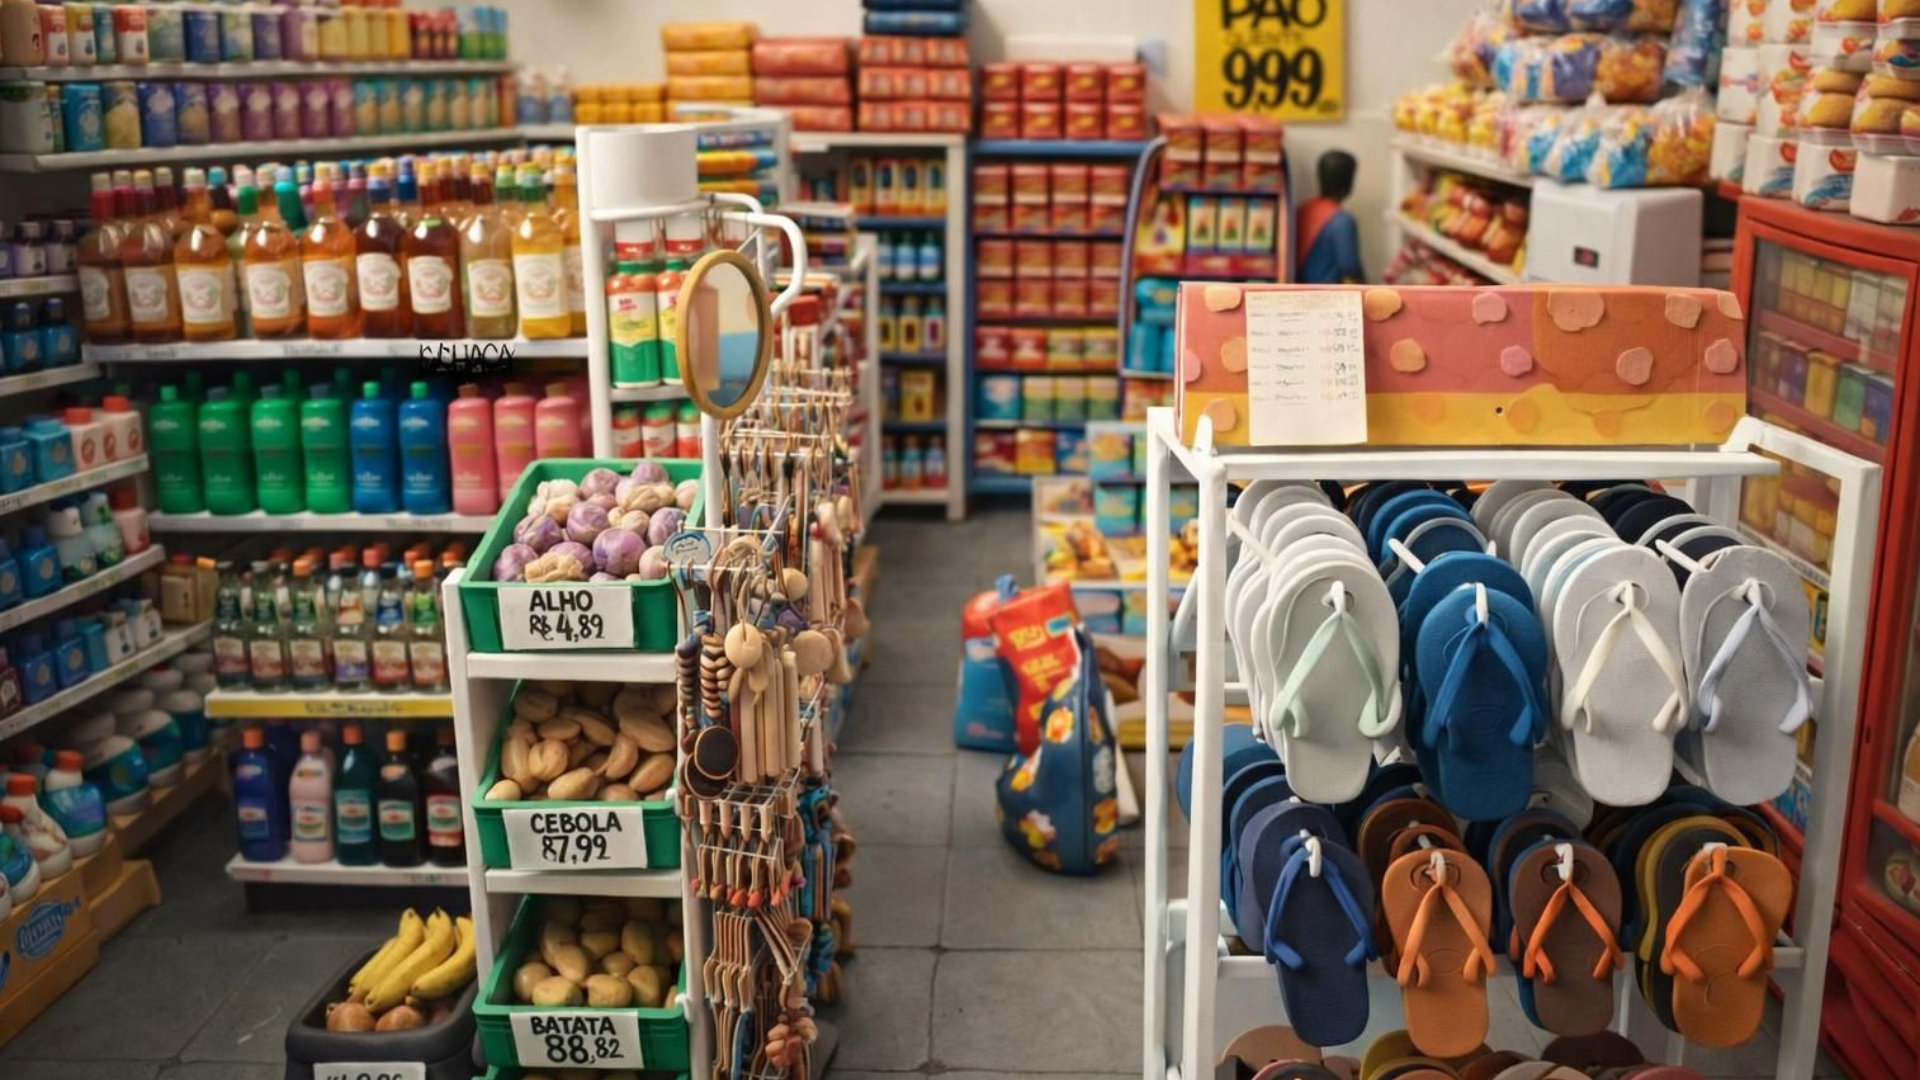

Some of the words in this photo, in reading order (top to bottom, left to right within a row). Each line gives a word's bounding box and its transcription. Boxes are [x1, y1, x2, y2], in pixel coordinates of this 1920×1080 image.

[529, 589, 594, 612] ALHO
[556, 613, 605, 642] 4,89
[530, 811, 622, 834] CEBOLA
[530, 1016, 617, 1036] BATATA
[545, 1034, 625, 1064] 88,82
